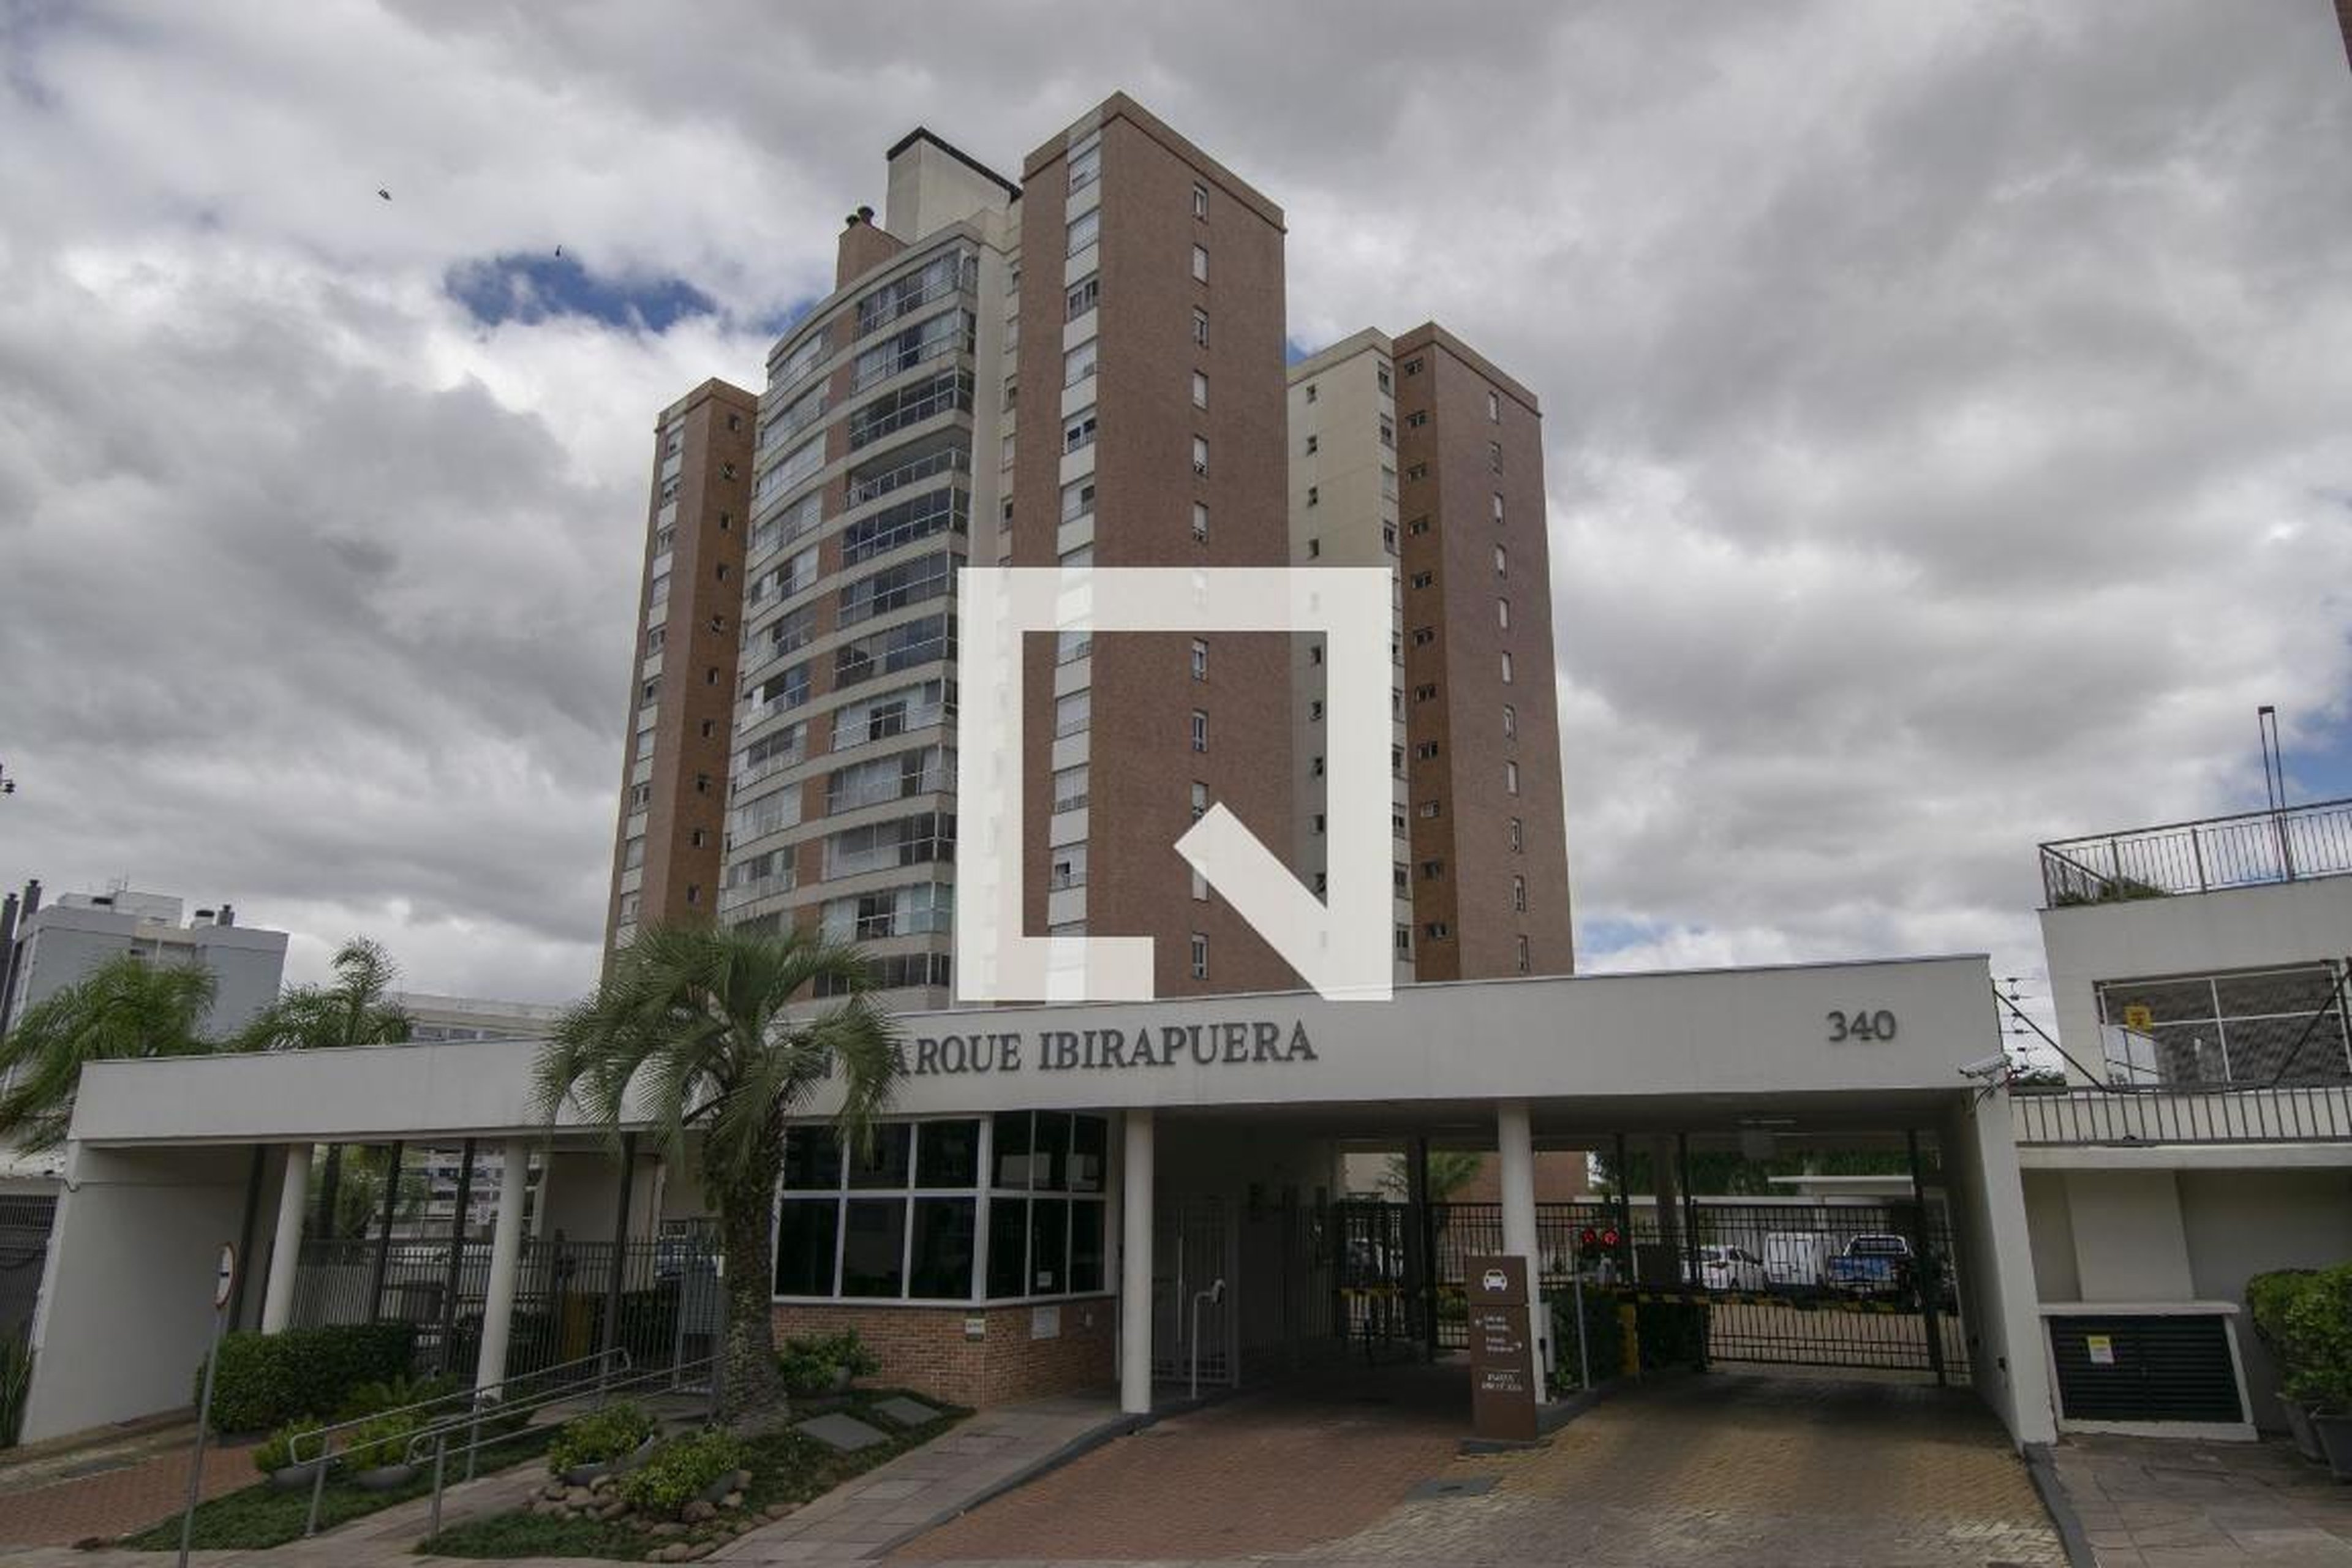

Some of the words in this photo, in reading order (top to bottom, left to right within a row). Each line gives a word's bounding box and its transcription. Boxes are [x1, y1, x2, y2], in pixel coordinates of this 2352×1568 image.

[882, 1033, 1022, 1076] ARQUE
[1038, 1019, 1318, 1071] IBIRAPUERA
[1827, 1010, 1896, 1042] 340
